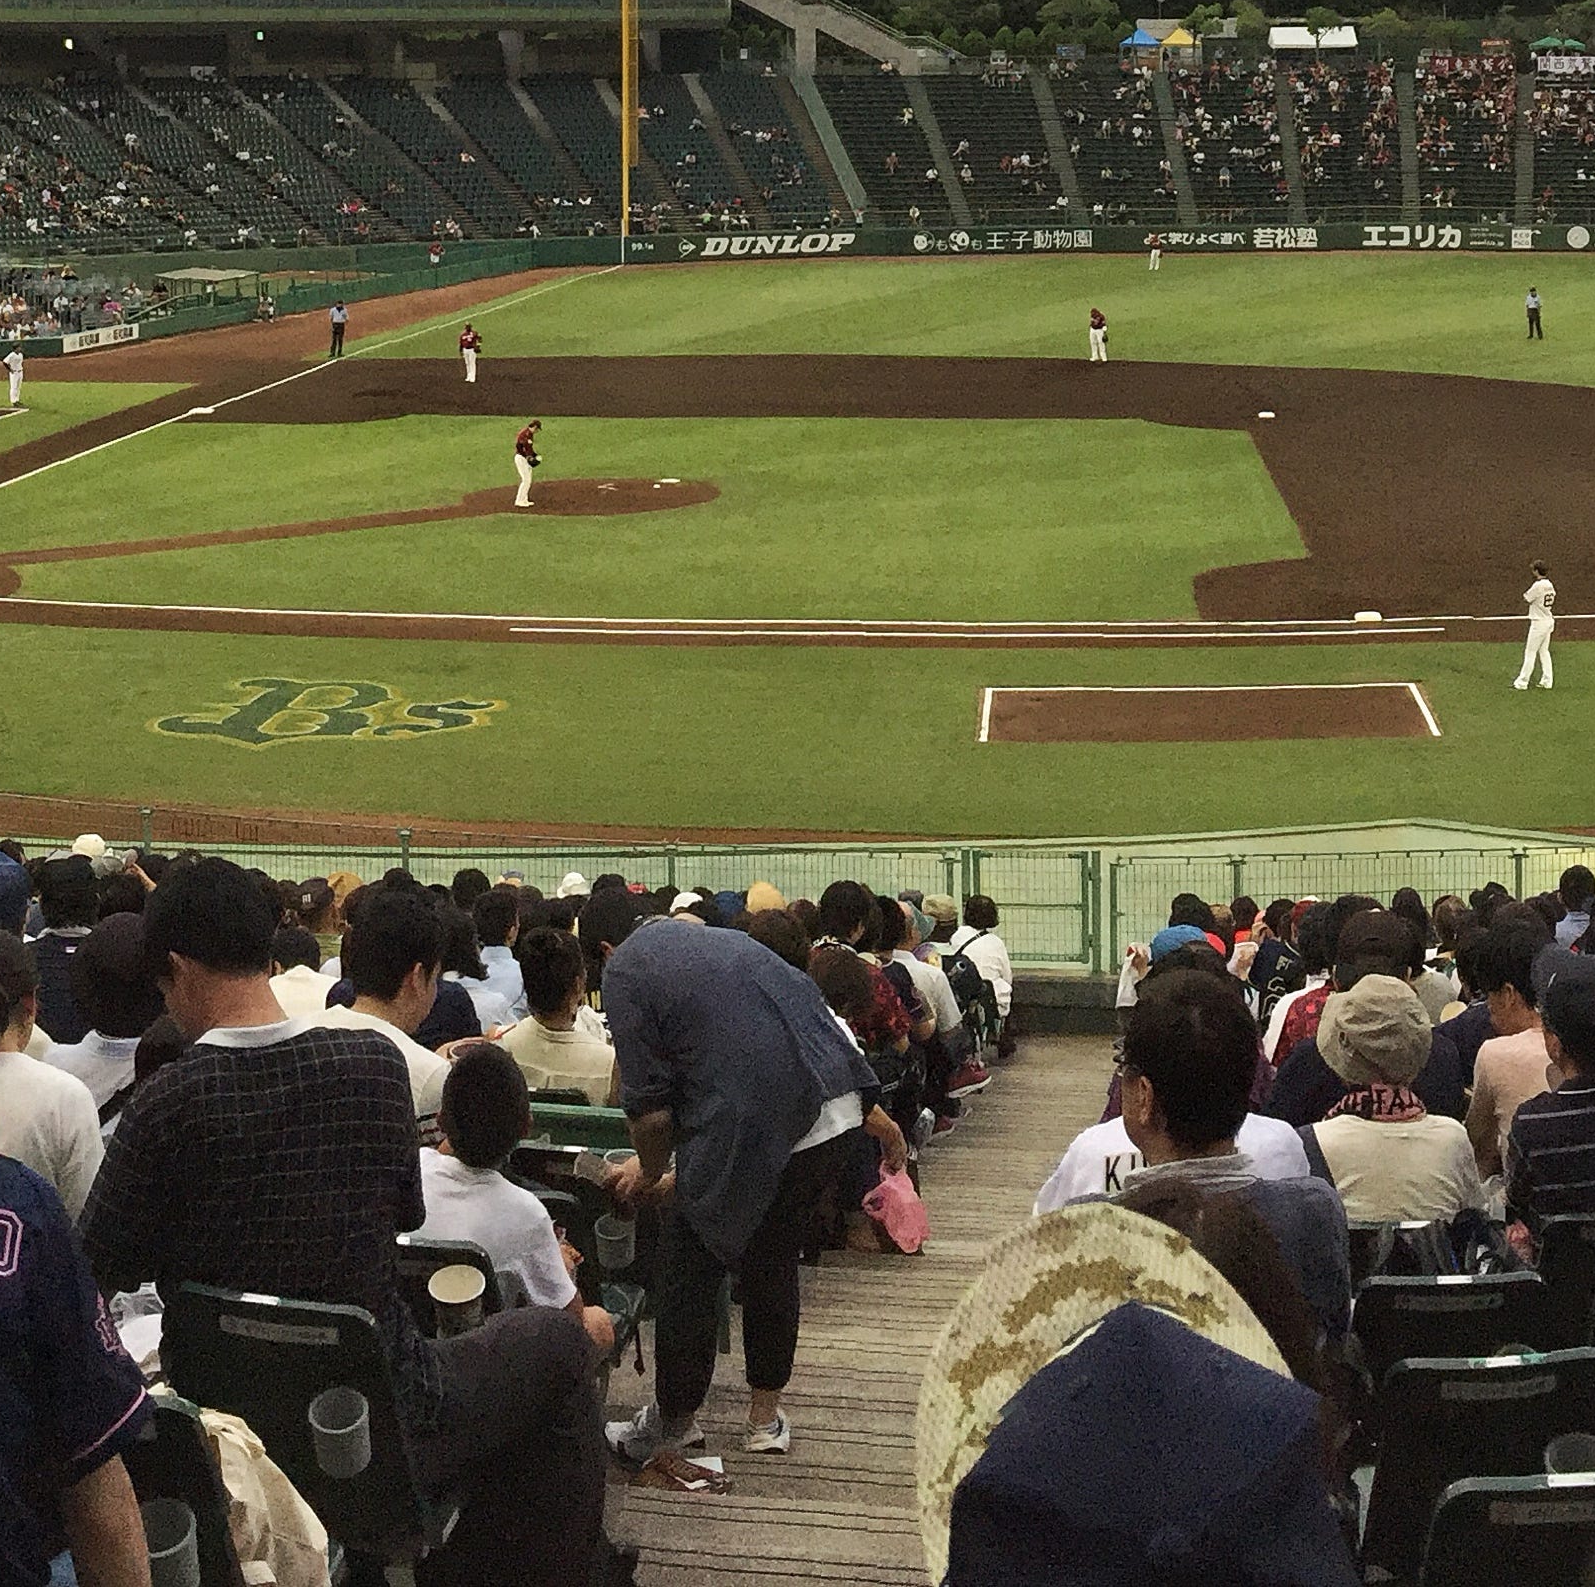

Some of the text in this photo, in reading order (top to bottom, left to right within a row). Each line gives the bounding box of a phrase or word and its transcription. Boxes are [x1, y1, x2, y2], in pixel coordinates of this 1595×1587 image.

[701, 233, 855, 256] DUNLOP
[1253, 227, 1318, 248] 若松塾
[1362, 224, 1462, 248] エコリカ
[150, 678, 500, 748] Bs
